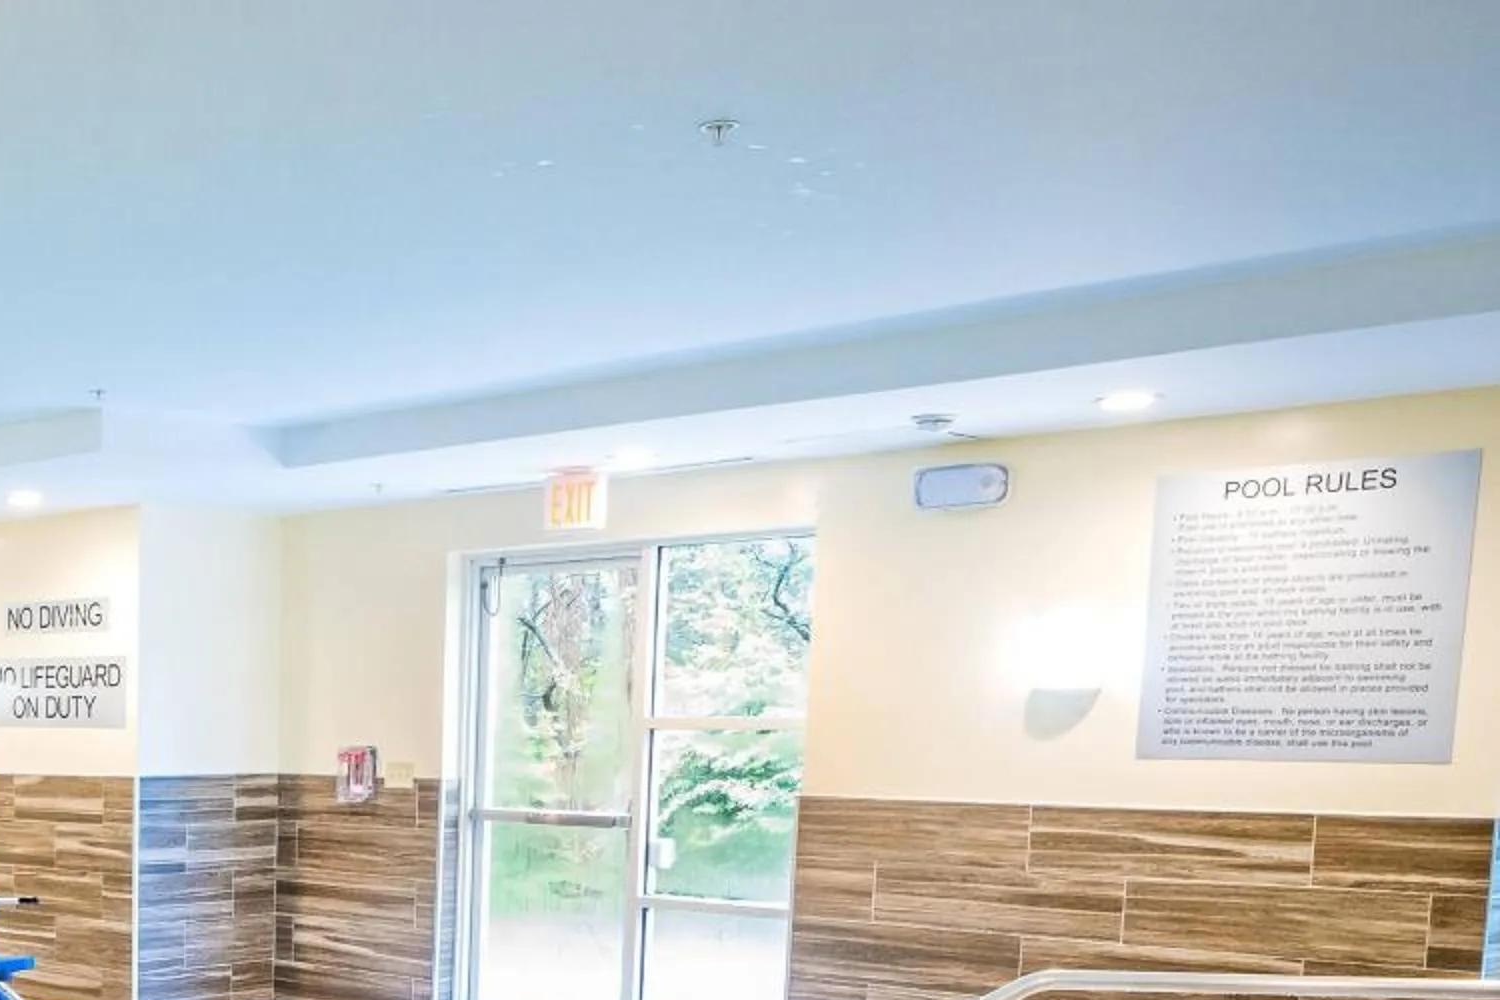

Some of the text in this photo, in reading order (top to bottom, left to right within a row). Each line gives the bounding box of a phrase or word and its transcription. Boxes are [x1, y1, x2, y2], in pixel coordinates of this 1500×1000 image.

[1224, 467, 1398, 500] POOL RULES
[550, 480, 596, 525] EXIT
[7, 601, 103, 630] NO DIVING
[21, 663, 121, 688] LIFEGUARD
[13, 695, 97, 719] ON DUTY
